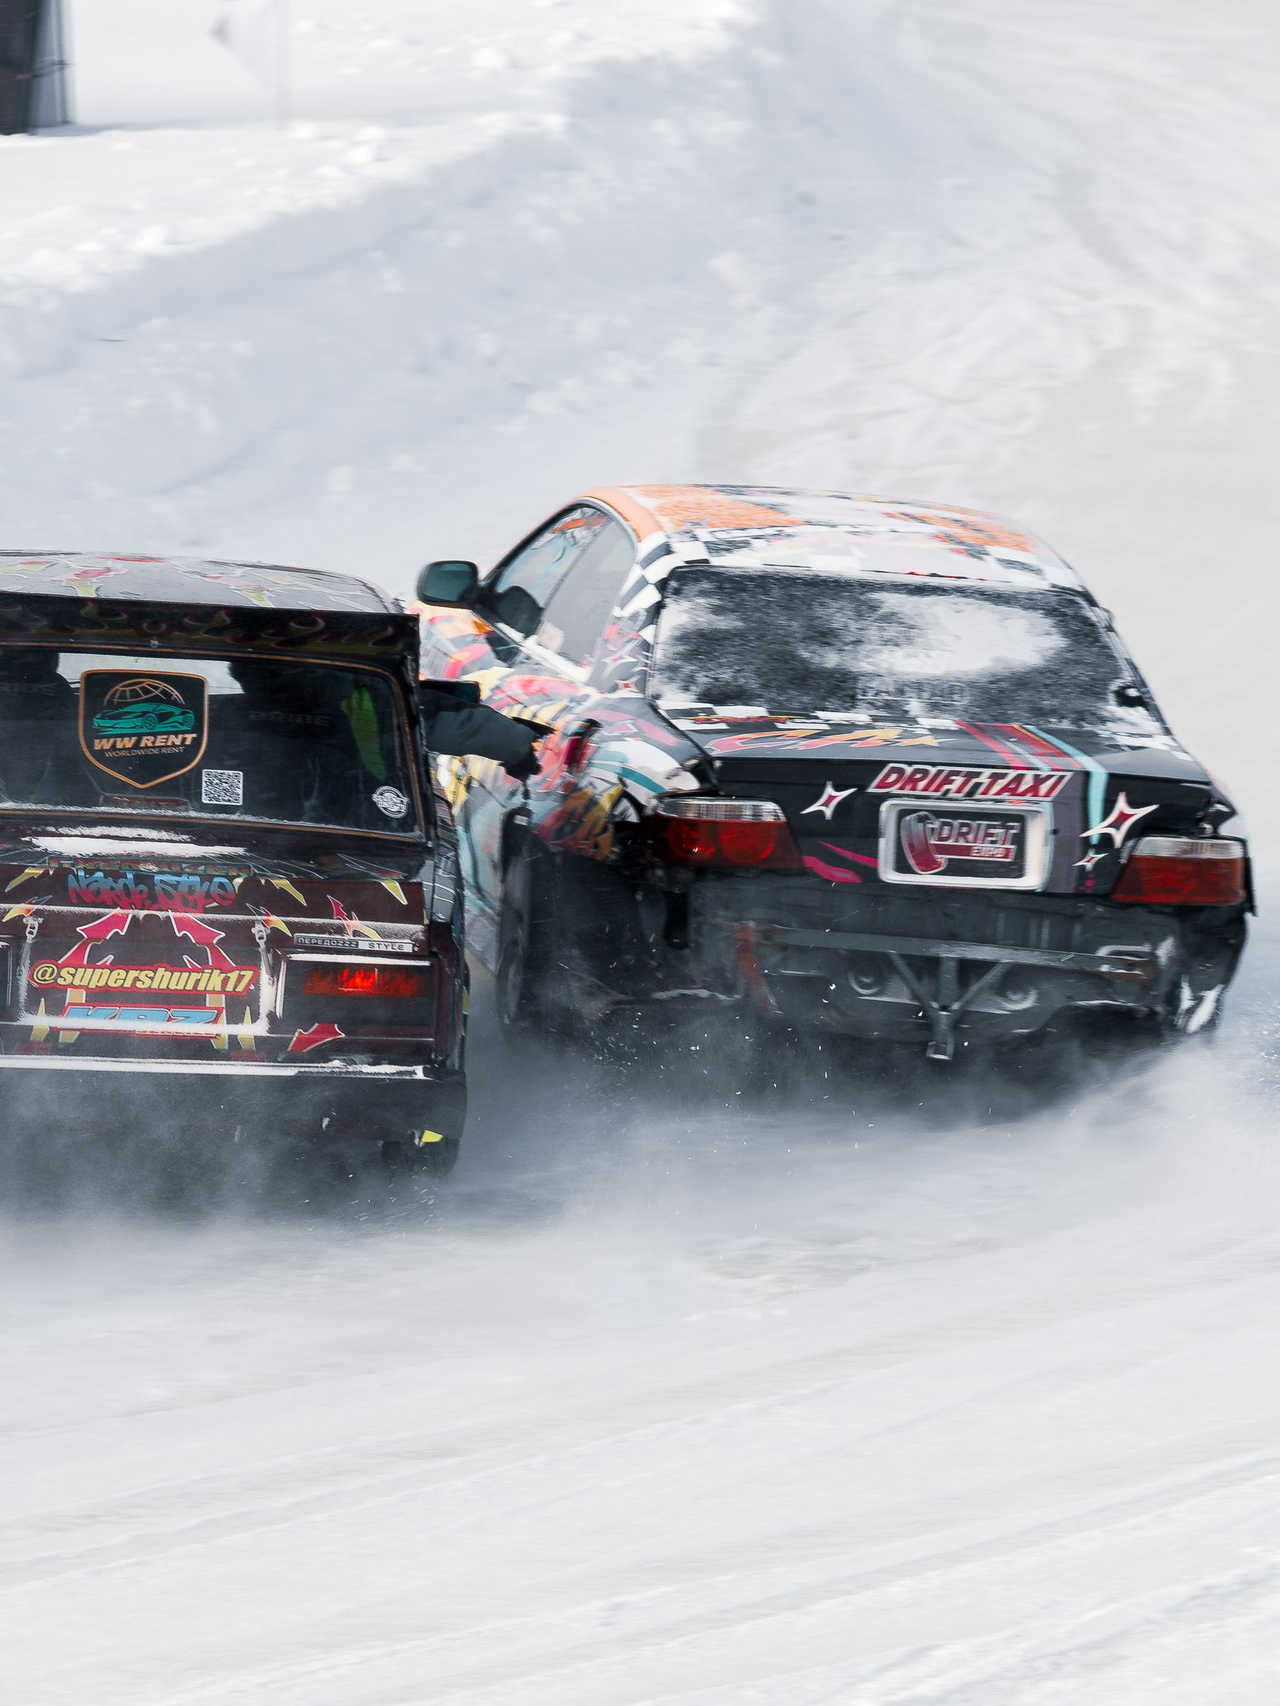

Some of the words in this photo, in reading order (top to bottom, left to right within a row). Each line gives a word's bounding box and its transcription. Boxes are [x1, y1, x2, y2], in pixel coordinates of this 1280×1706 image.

[93, 736, 138, 750] WW
[139, 733, 198, 747] RENT
[104, 748, 160, 757] WORLDWIDE
[161, 746, 185, 754] RENT
[934, 819, 1022, 845] DRIFT
[368, 942, 405, 951] STYLE
[32, 963, 255, 992] @supershurik17
